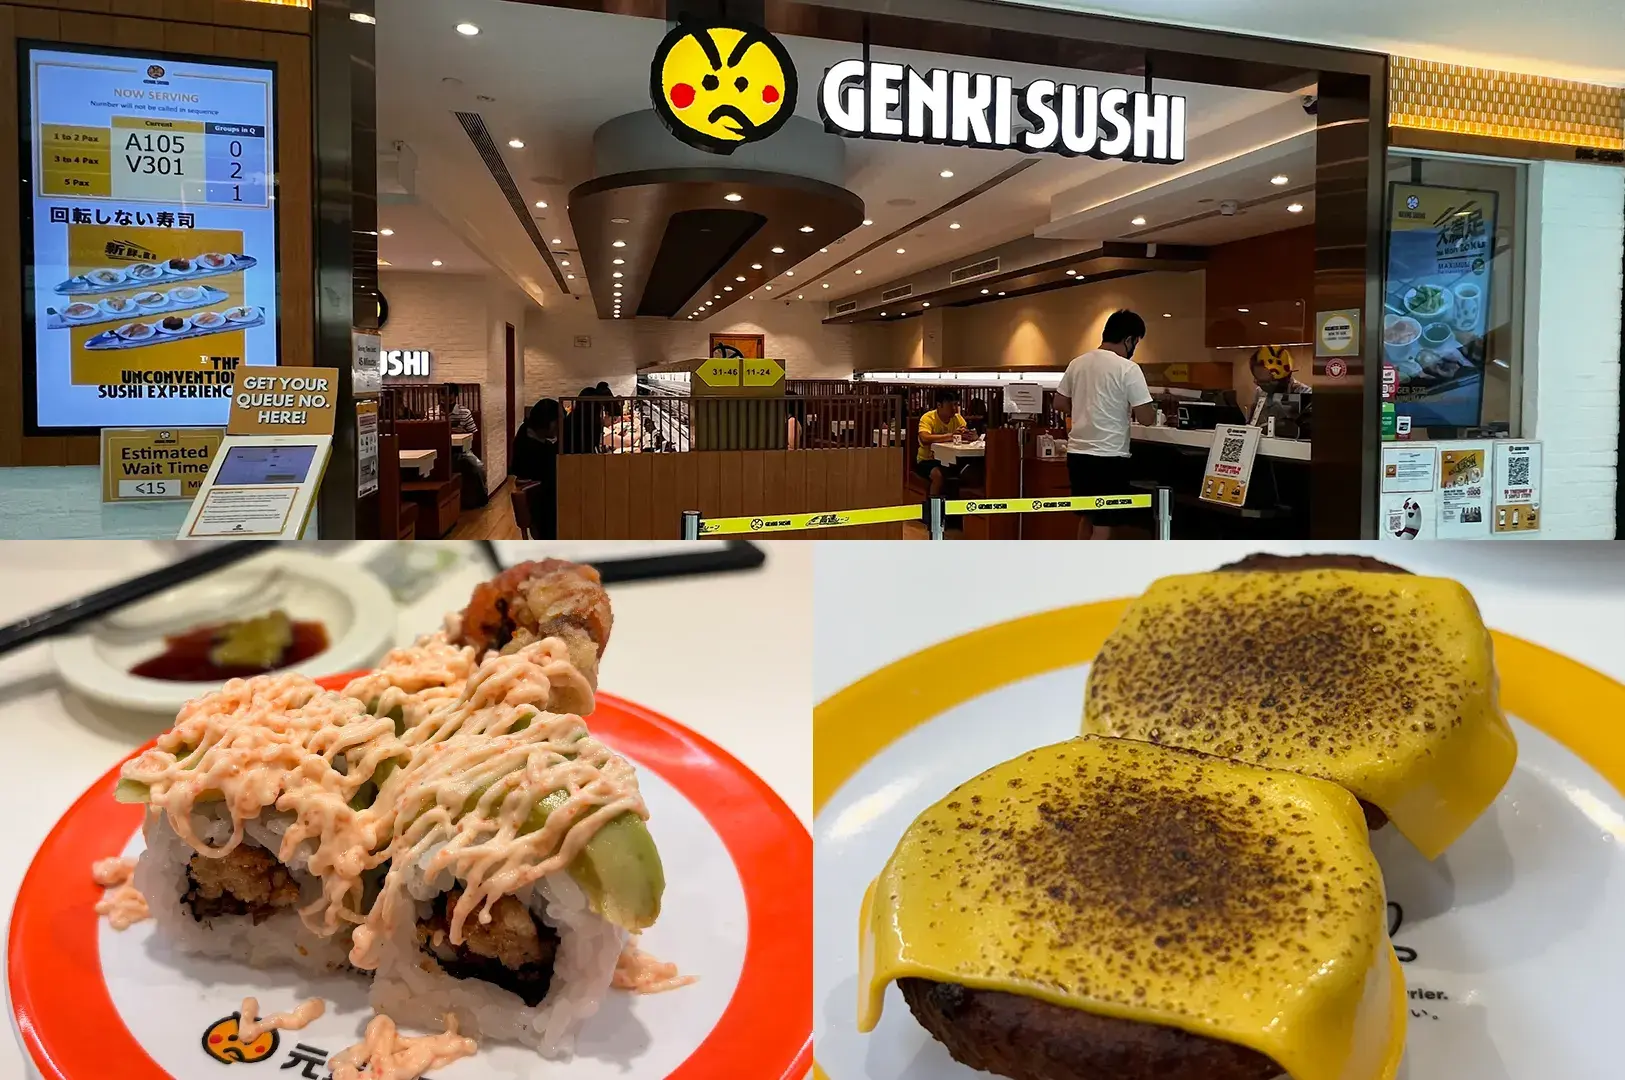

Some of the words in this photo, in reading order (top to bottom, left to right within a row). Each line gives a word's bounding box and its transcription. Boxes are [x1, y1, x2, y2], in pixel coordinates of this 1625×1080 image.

[114, 88, 144, 98] NOW
[148, 90, 199, 103] SERVING
[90, 100, 118, 108] Number
[158, 105, 178, 113] called
[188, 108, 219, 116] sequence
[823, 61, 1012, 146] GENKI
[1024, 80, 1186, 161] SUSHI
[145, 120, 173, 128] Current
[215, 125, 240, 134] Groups
[249, 127, 256, 135] Q
[62, 133, 71, 141] to
[82, 134, 99, 143] Pax
[125, 133, 185, 154] A105
[230, 141, 242, 158] 0
[54, 155, 59, 163] 3
[62, 155, 71, 163] to
[73, 156, 80, 164] 4
[82, 157, 99, 165] Pax
[125, 154, 185, 175] V301
[230, 162, 242, 179] 2
[64, 178, 70, 186] 5
[73, 179, 90, 187] Pax
[233, 185, 243, 201] 1
[50, 207, 196, 229] 回転しない寿司
[210, 357, 240, 370] THE
[712, 368, 738, 376] 31-46
[746, 368, 771, 376] 11-24
[243, 376, 277, 390] GET
[279, 377, 328, 391] YOUR
[98, 385, 143, 399] SUSHI
[148, 385, 233, 399] EXPERIENC
[236, 393, 295, 409] QUEUE
[298, 394, 331, 408] NO.
[258, 410, 307, 424] HERE!
[121, 445, 209, 460] Estimated
[122, 462, 163, 475] Wait
[167, 461, 209, 474] Time
[135, 482, 166, 494] <15
